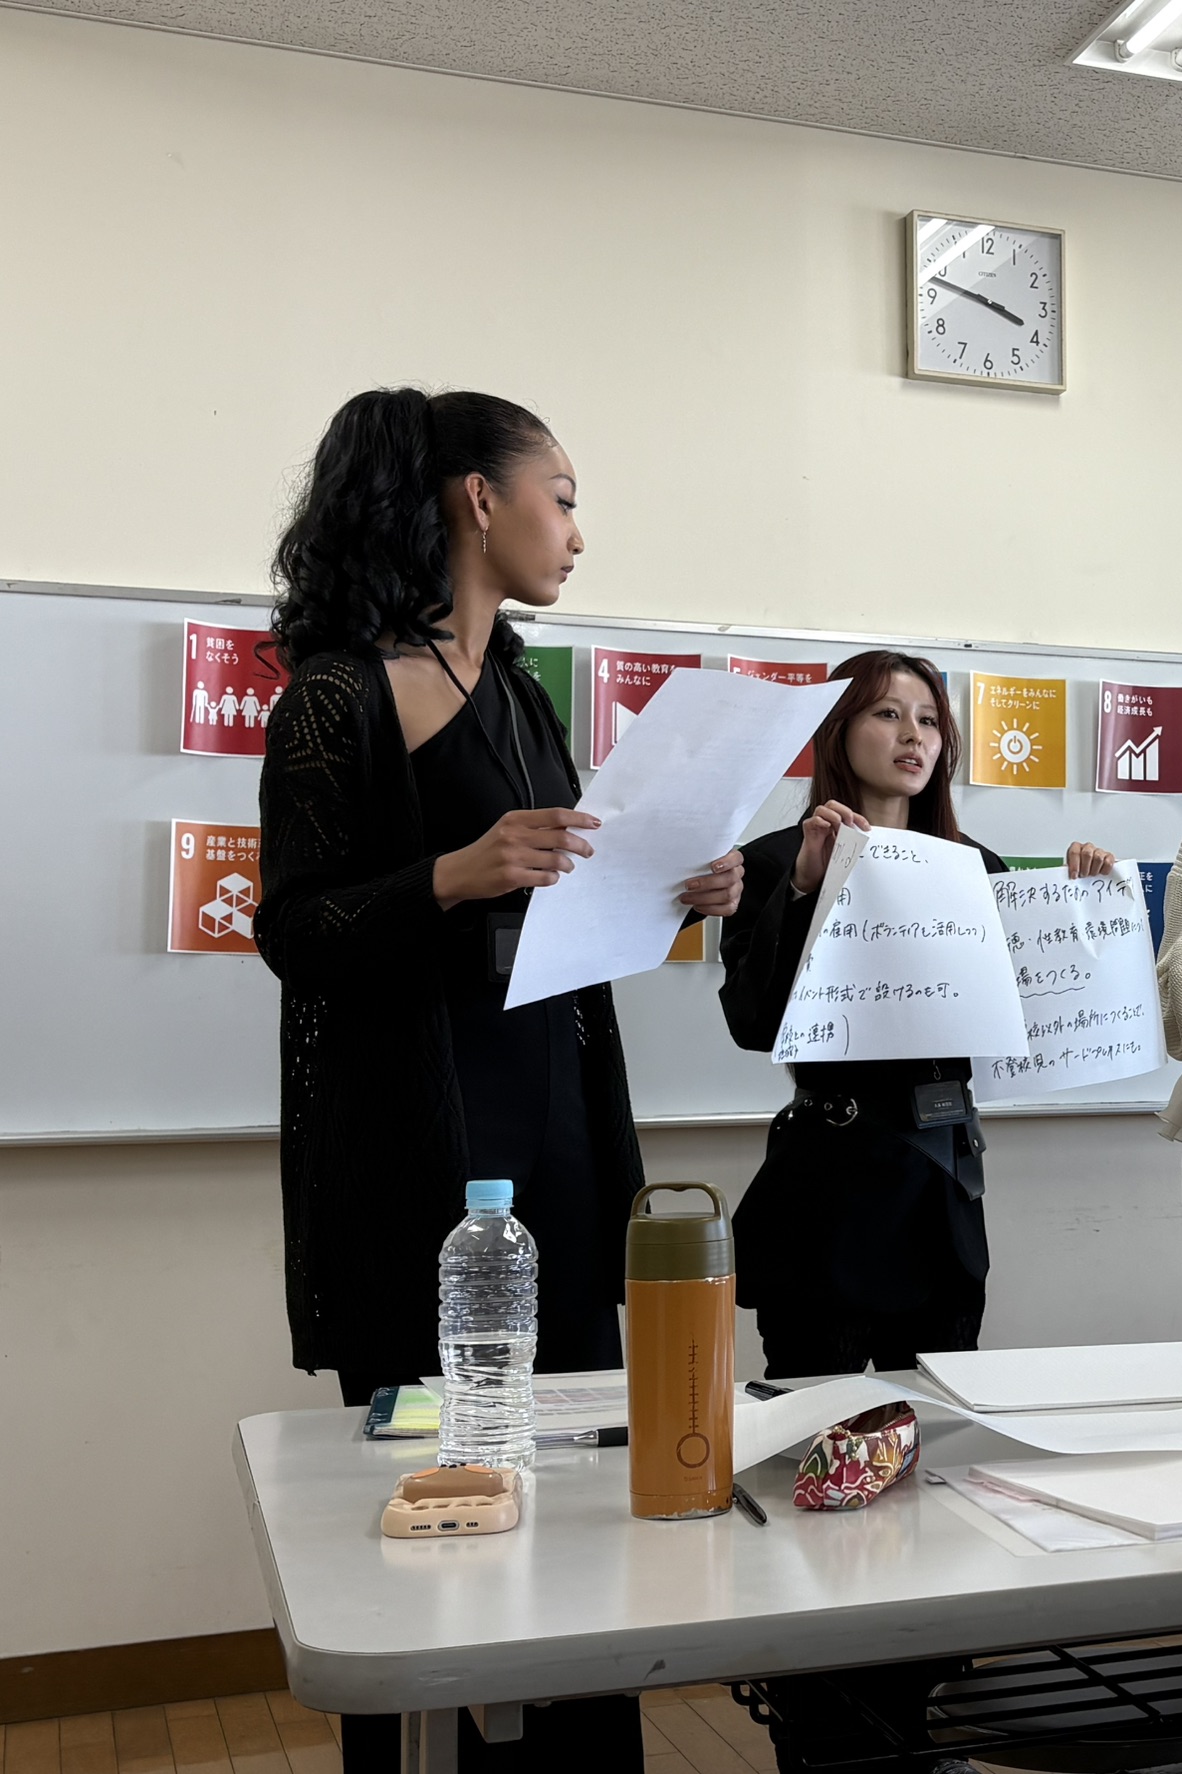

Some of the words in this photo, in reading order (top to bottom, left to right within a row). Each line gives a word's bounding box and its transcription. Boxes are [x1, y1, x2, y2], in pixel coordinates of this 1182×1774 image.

[981, 237, 995, 255] 12
[1012, 248, 1016, 266] 1
[1029, 272, 1039, 289] 2
[927, 287, 938, 305] 9
[1038, 301, 1048, 318] 3
[936, 318, 946, 335] 8
[1029, 329, 1040, 346] 4
[957, 341, 968, 359] 7
[1010, 348, 1021, 365] 5
[983, 353, 994, 370] 6
[189, 633, 197, 660] 1
[206, 636, 235, 650] 貧困を
[206, 651, 239, 665] なくそう
[598, 659, 610, 684] 4
[616, 674, 651, 686] みんなに
[976, 682, 986, 705] 7
[990, 685, 1057, 698] エネルギーをみんなに
[1117, 693, 1153, 705] 働きがいも
[990, 698, 1040, 710] そしてクリーンに
[1103, 690, 1112, 714] 8
[1116, 705, 1153, 717] 経済成長も
[181, 832, 195, 860] 9
[206, 835, 260, 849] 産業と技術
[859, 845, 929, 863] できること、
[818, 918, 986, 942] の雇用(ボランティアも活用しつつ)
[1024, 1004, 1145, 1041] 校以外の場所につくることで、
